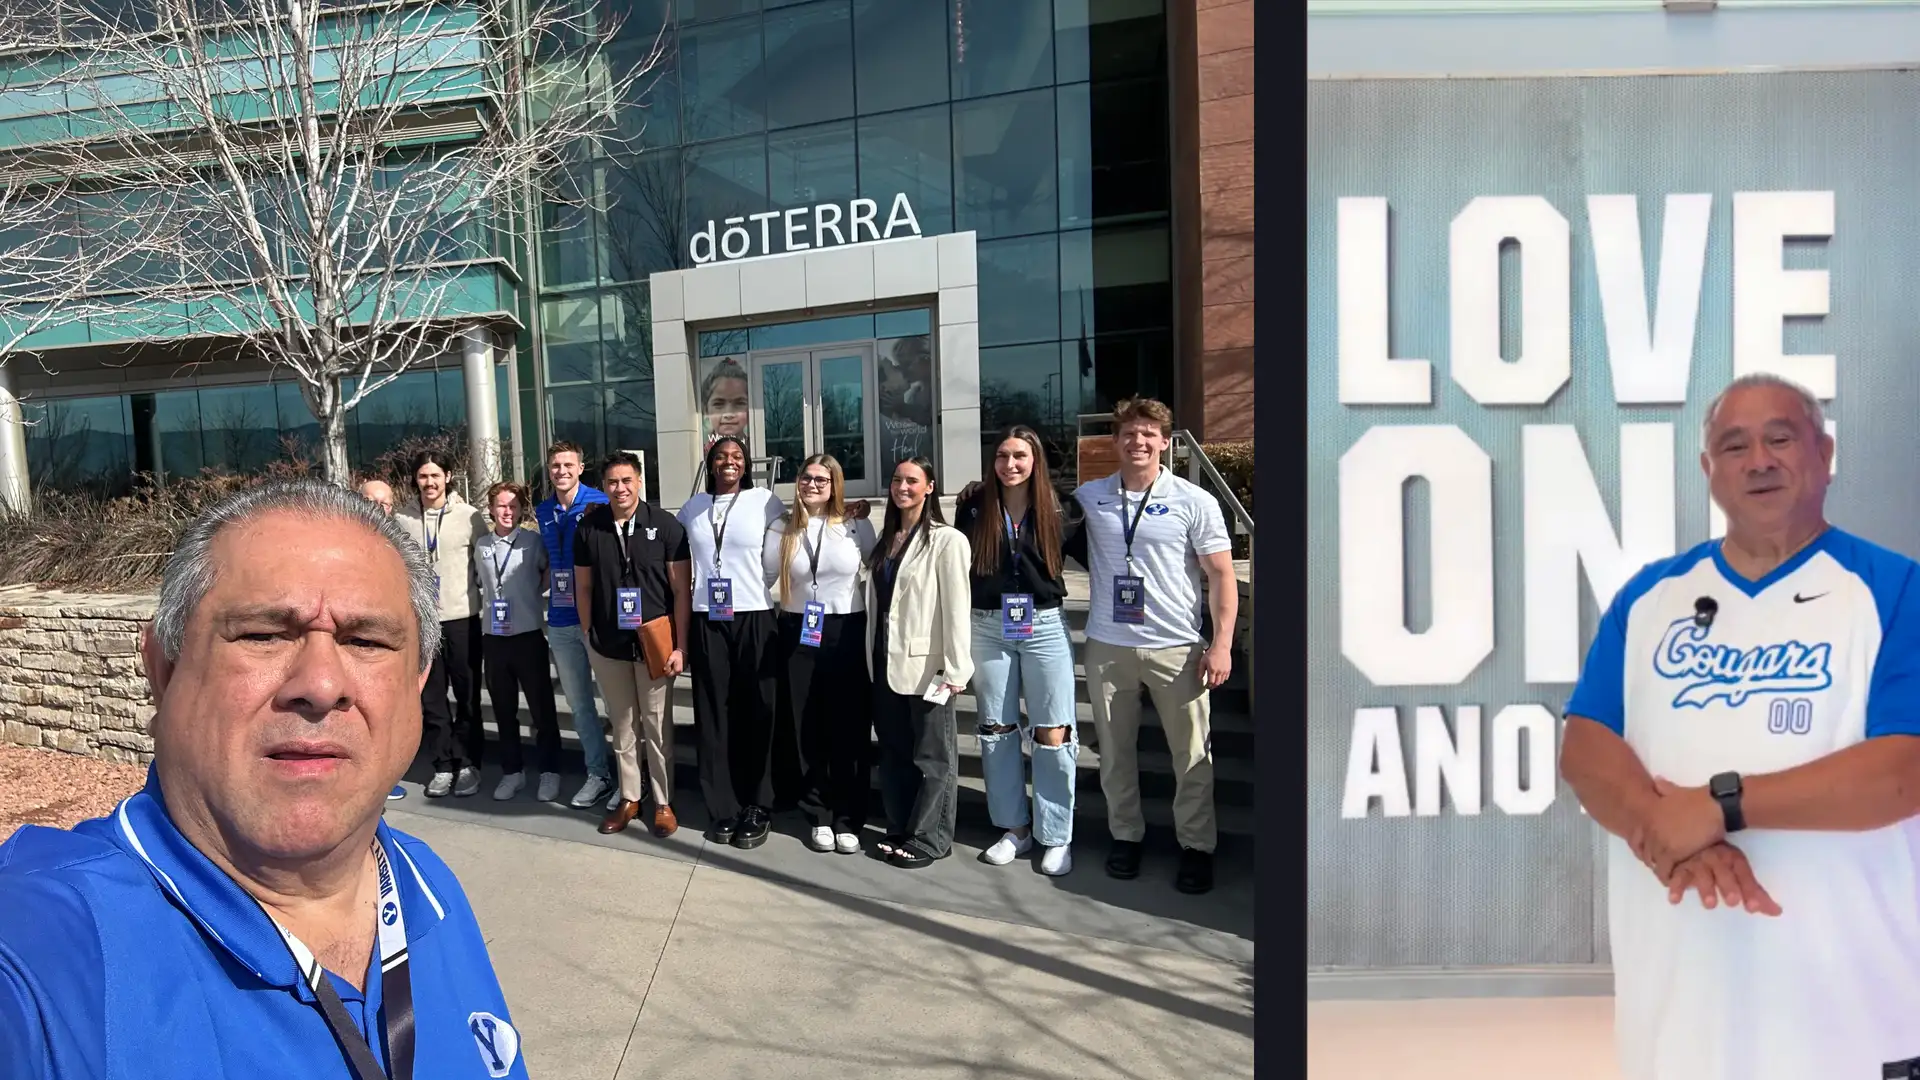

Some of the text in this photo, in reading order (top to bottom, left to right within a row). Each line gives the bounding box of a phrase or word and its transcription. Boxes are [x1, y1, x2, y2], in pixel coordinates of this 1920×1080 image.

[690, 192, 922, 263] dōTERRA
[1337, 190, 1836, 404] LOVE
[1339, 421, 1836, 686] ON
[1653, 616, 1832, 709] Cougars
[1342, 704, 1566, 820] ANO
[1768, 698, 1812, 735] 00
[374, 845, 394, 899] VARSITY
